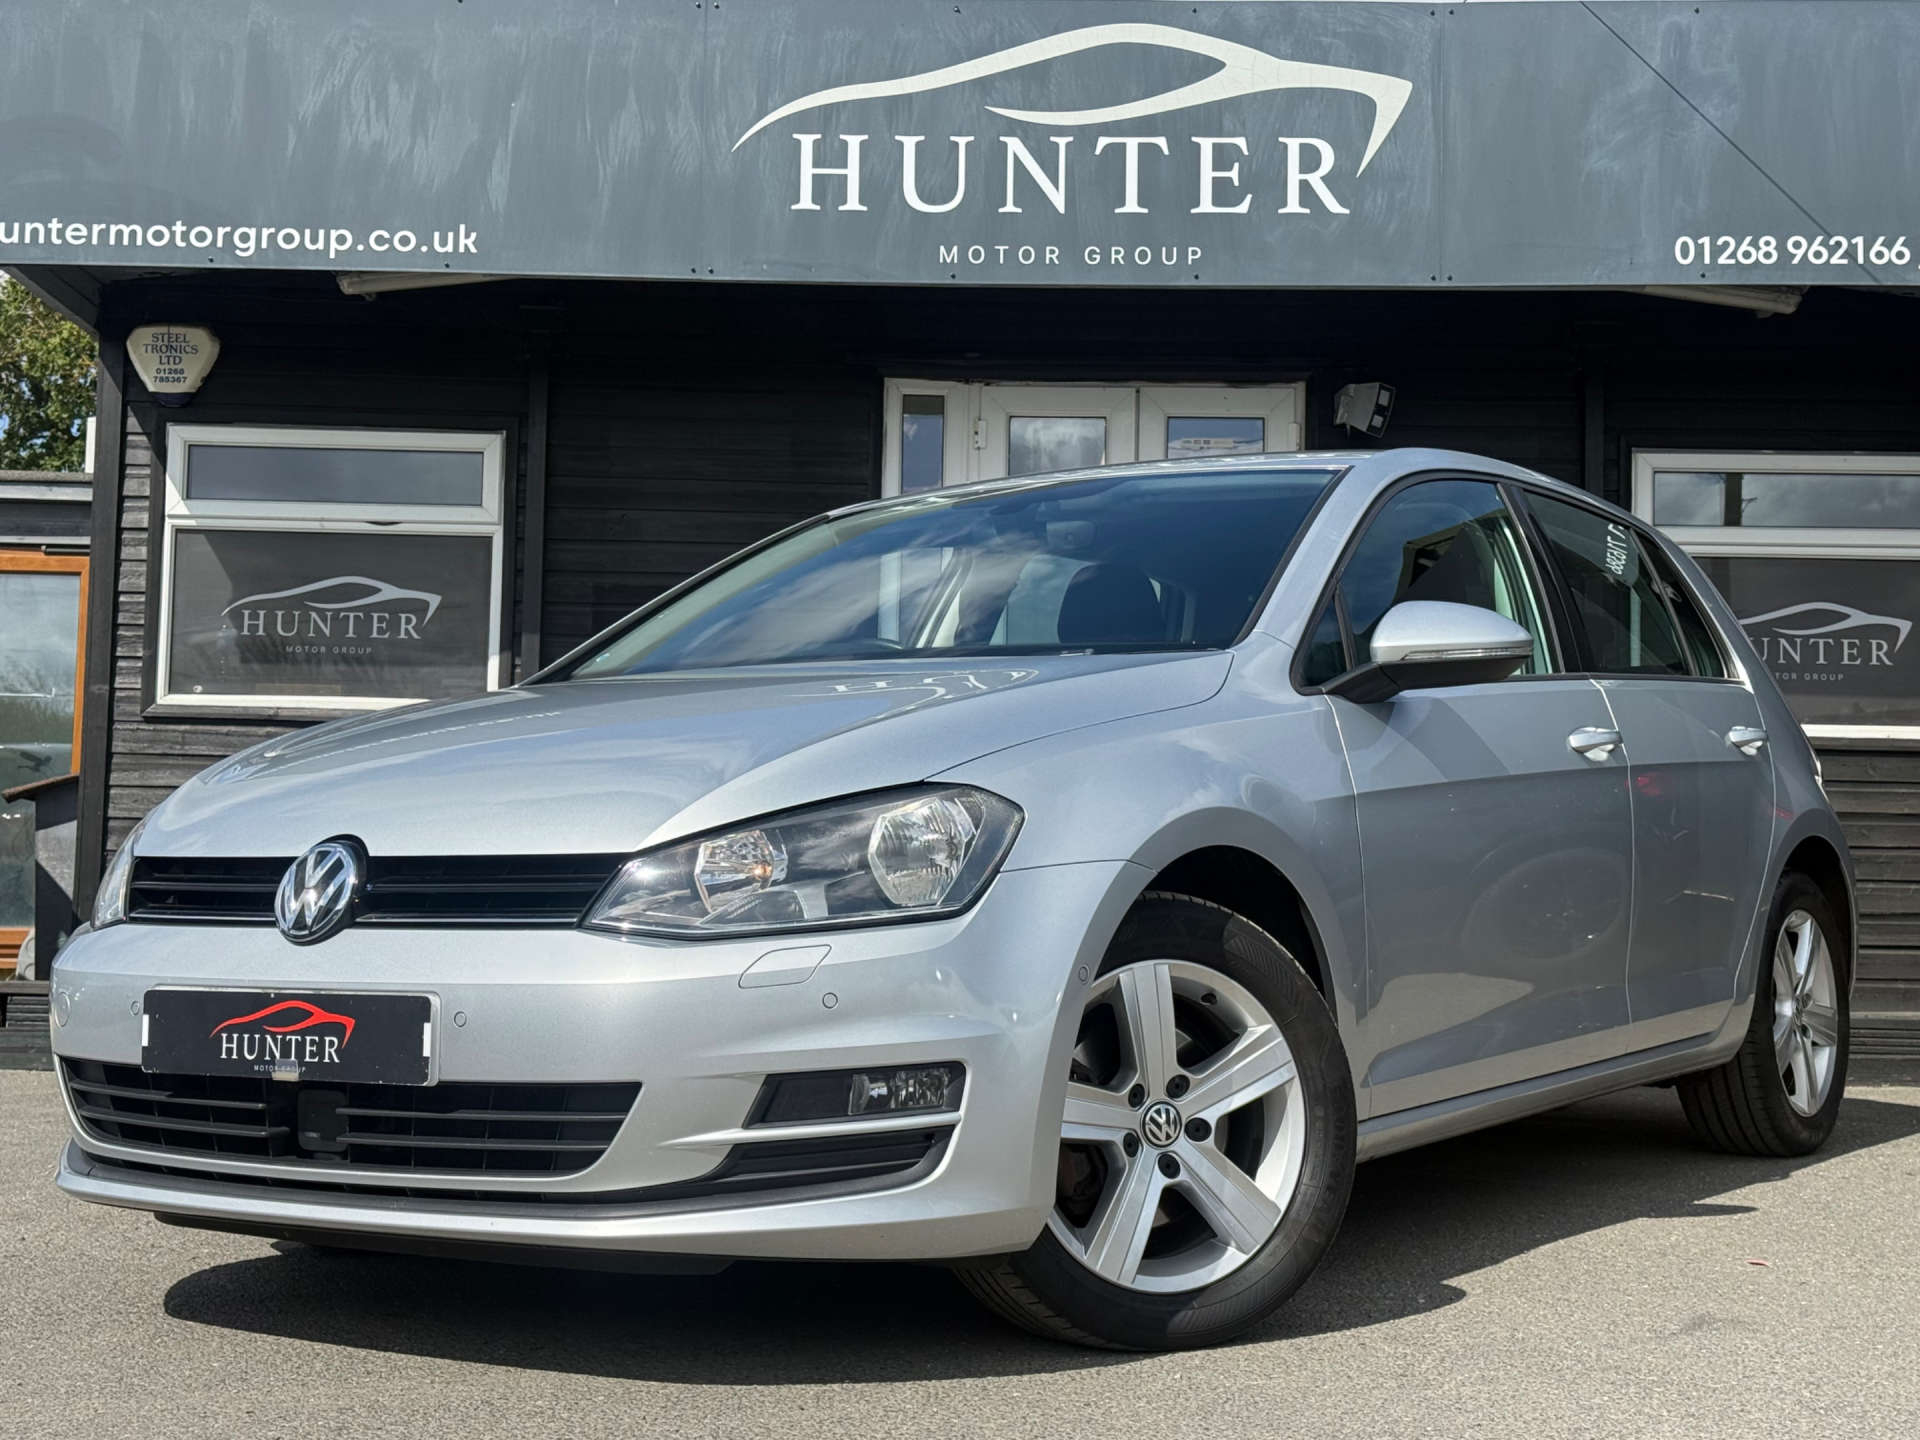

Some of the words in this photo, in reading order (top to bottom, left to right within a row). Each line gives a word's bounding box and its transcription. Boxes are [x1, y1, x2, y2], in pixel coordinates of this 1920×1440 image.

[790, 133, 1351, 215] HUNTER
[0, 217, 478, 259] untermotorgroup.co.uk
[1674, 235, 1779, 265] 01268
[1786, 235, 1911, 265] 962166
[939, 245, 1060, 265] MOTOR
[1084, 246, 1202, 266] GROUP
[143, 344, 199, 355] TRONICS
[151, 333, 190, 343] STEEL
[159, 355, 183, 366] LTD
[240, 609, 422, 640] HUNTER
[285, 645, 326, 655] MOTOR
[332, 646, 372, 655] GROUP
[1750, 637, 1894, 666] UNTER
[1804, 672, 1844, 681] GROUP
[220, 1033, 340, 1064] HUNTER
